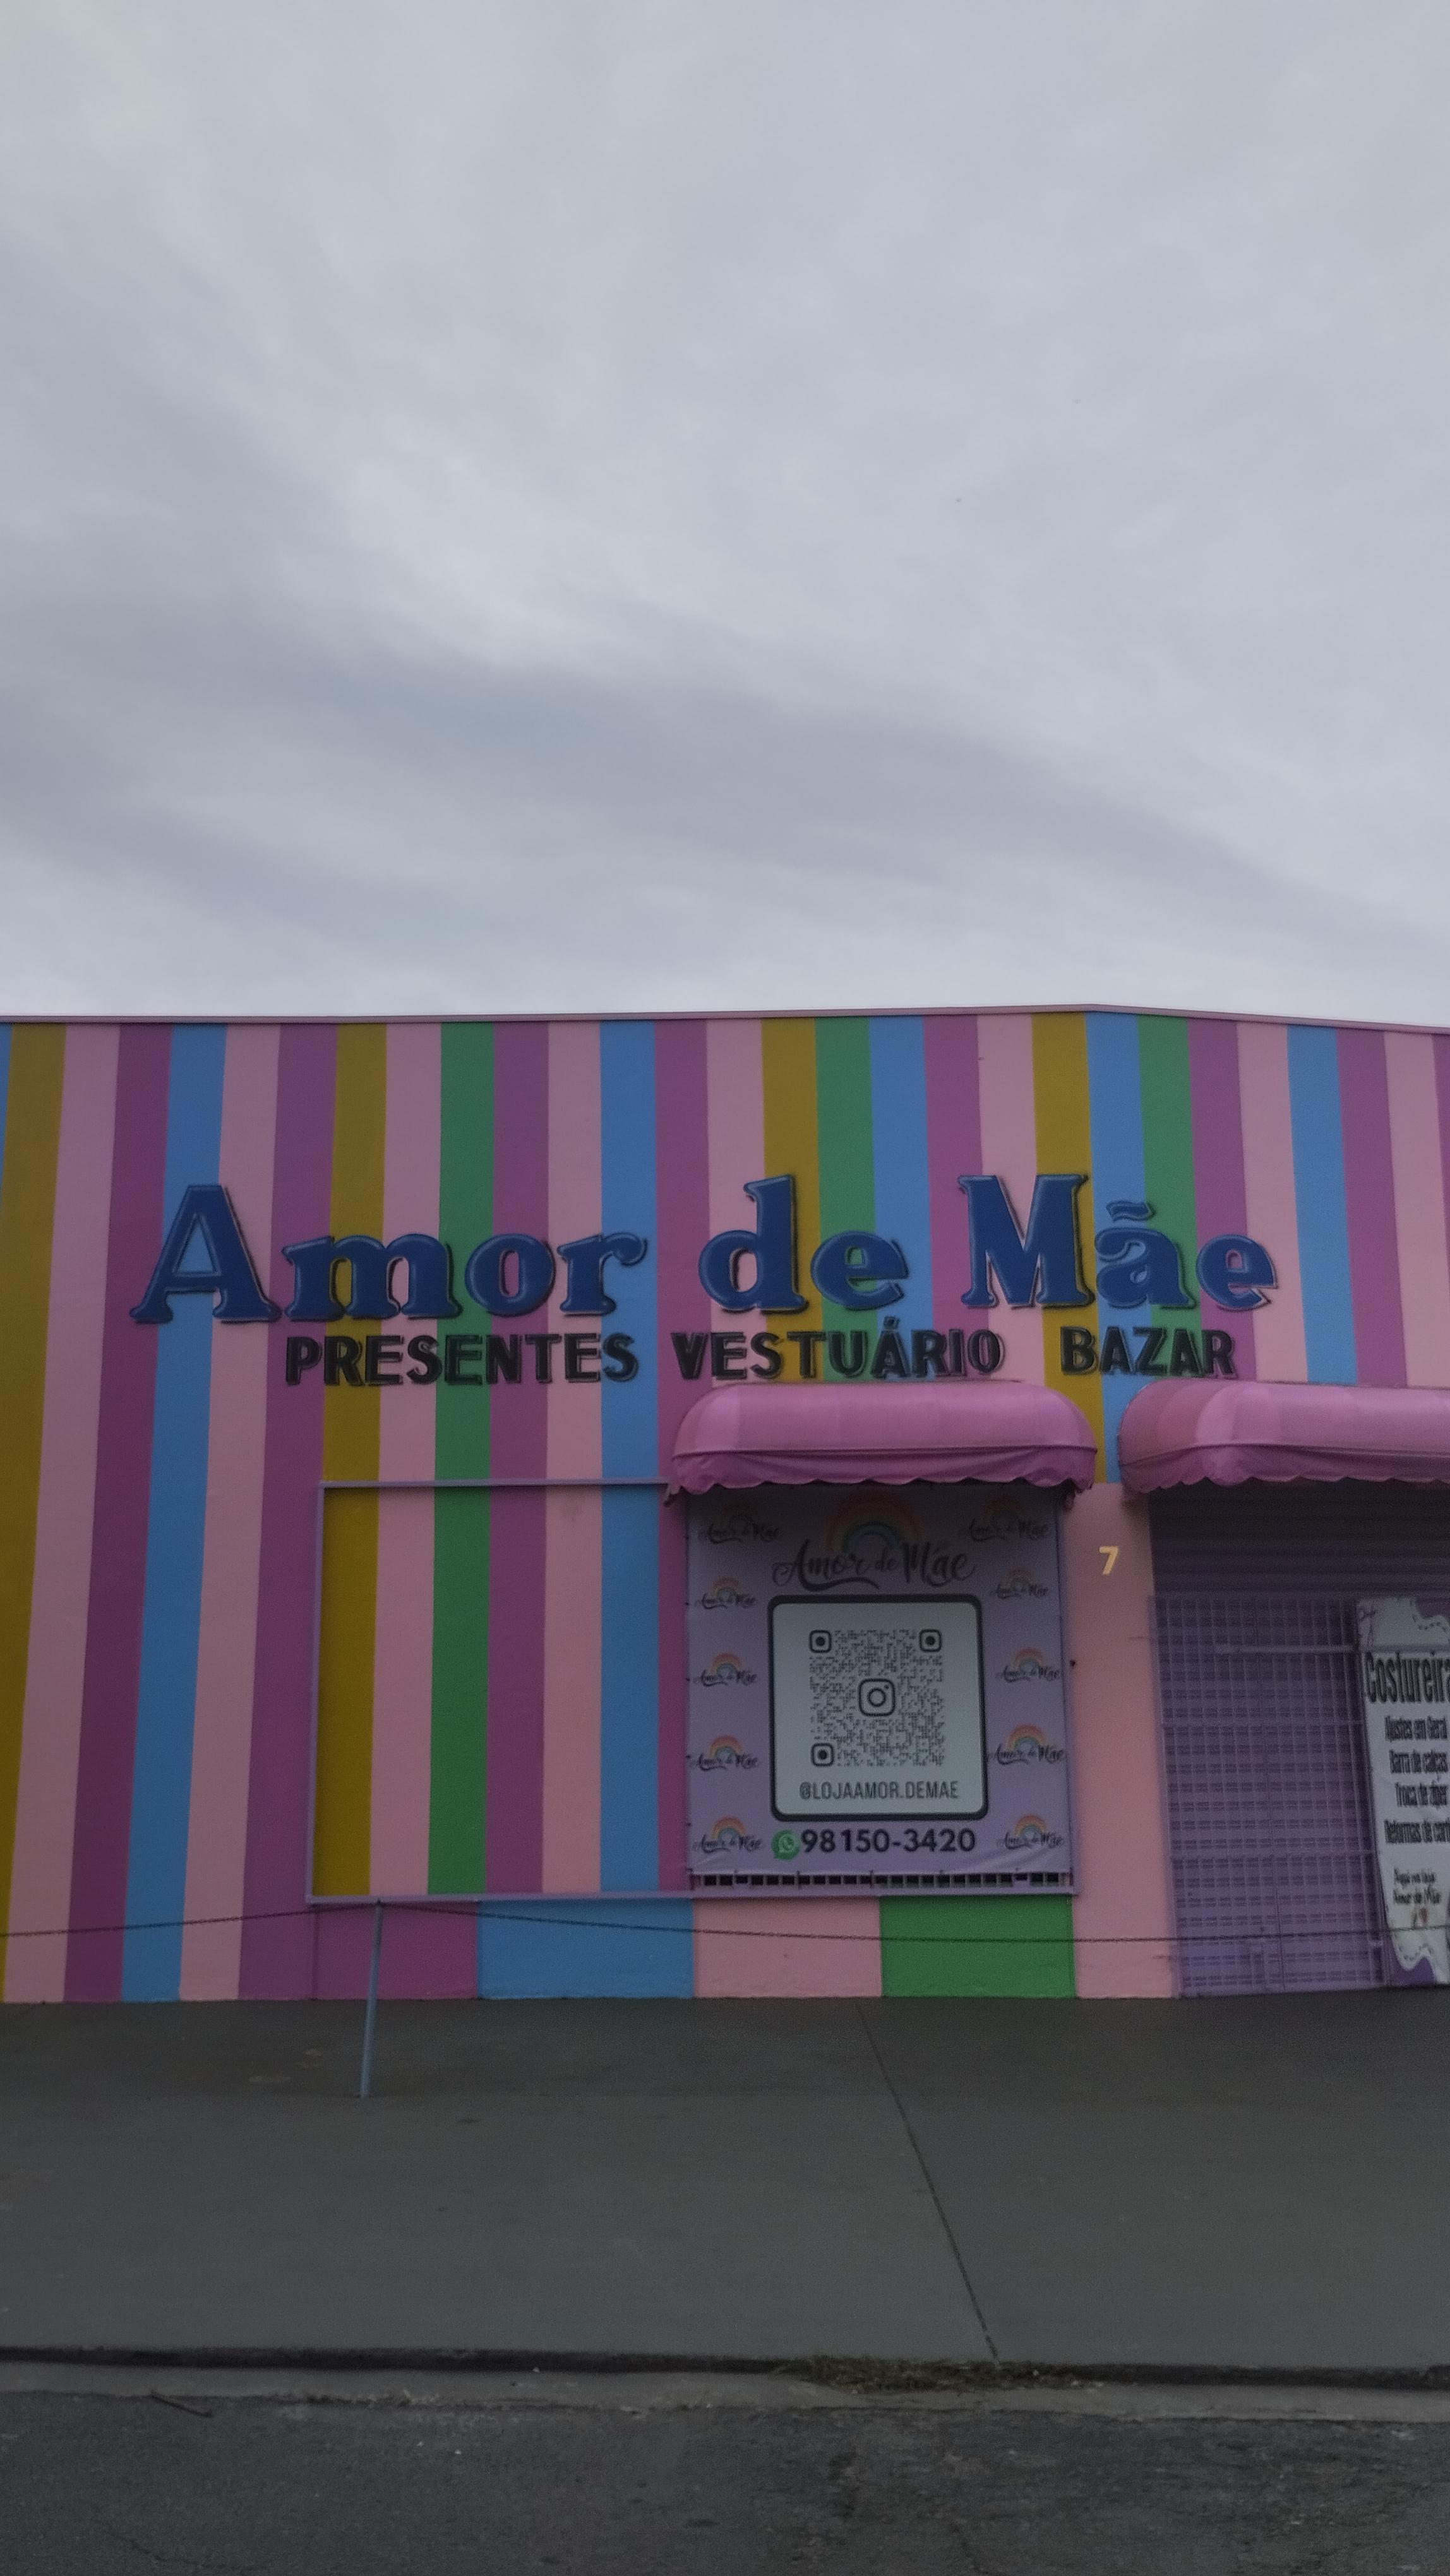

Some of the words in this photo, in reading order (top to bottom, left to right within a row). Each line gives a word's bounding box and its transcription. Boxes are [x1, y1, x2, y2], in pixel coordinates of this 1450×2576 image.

[129, 1184, 648, 1325] Amor
[698, 1174, 910, 1314] de
[957, 1174, 1279, 1311] Mãe
[284, 1332, 640, 1386] PRESENTES
[670, 1316, 1006, 1382] VESTUÁRIO
[1059, 1325, 1237, 1379] BAZAR
[772, 1538, 880, 1592] Amor
[875, 1546, 899, 1572] de
[1099, 1545, 1119, 1576] 7
[798, 1781, 959, 1800] @LOJAAMOR.DEMAE
[800, 1828, 977, 1854] 98150-3420
